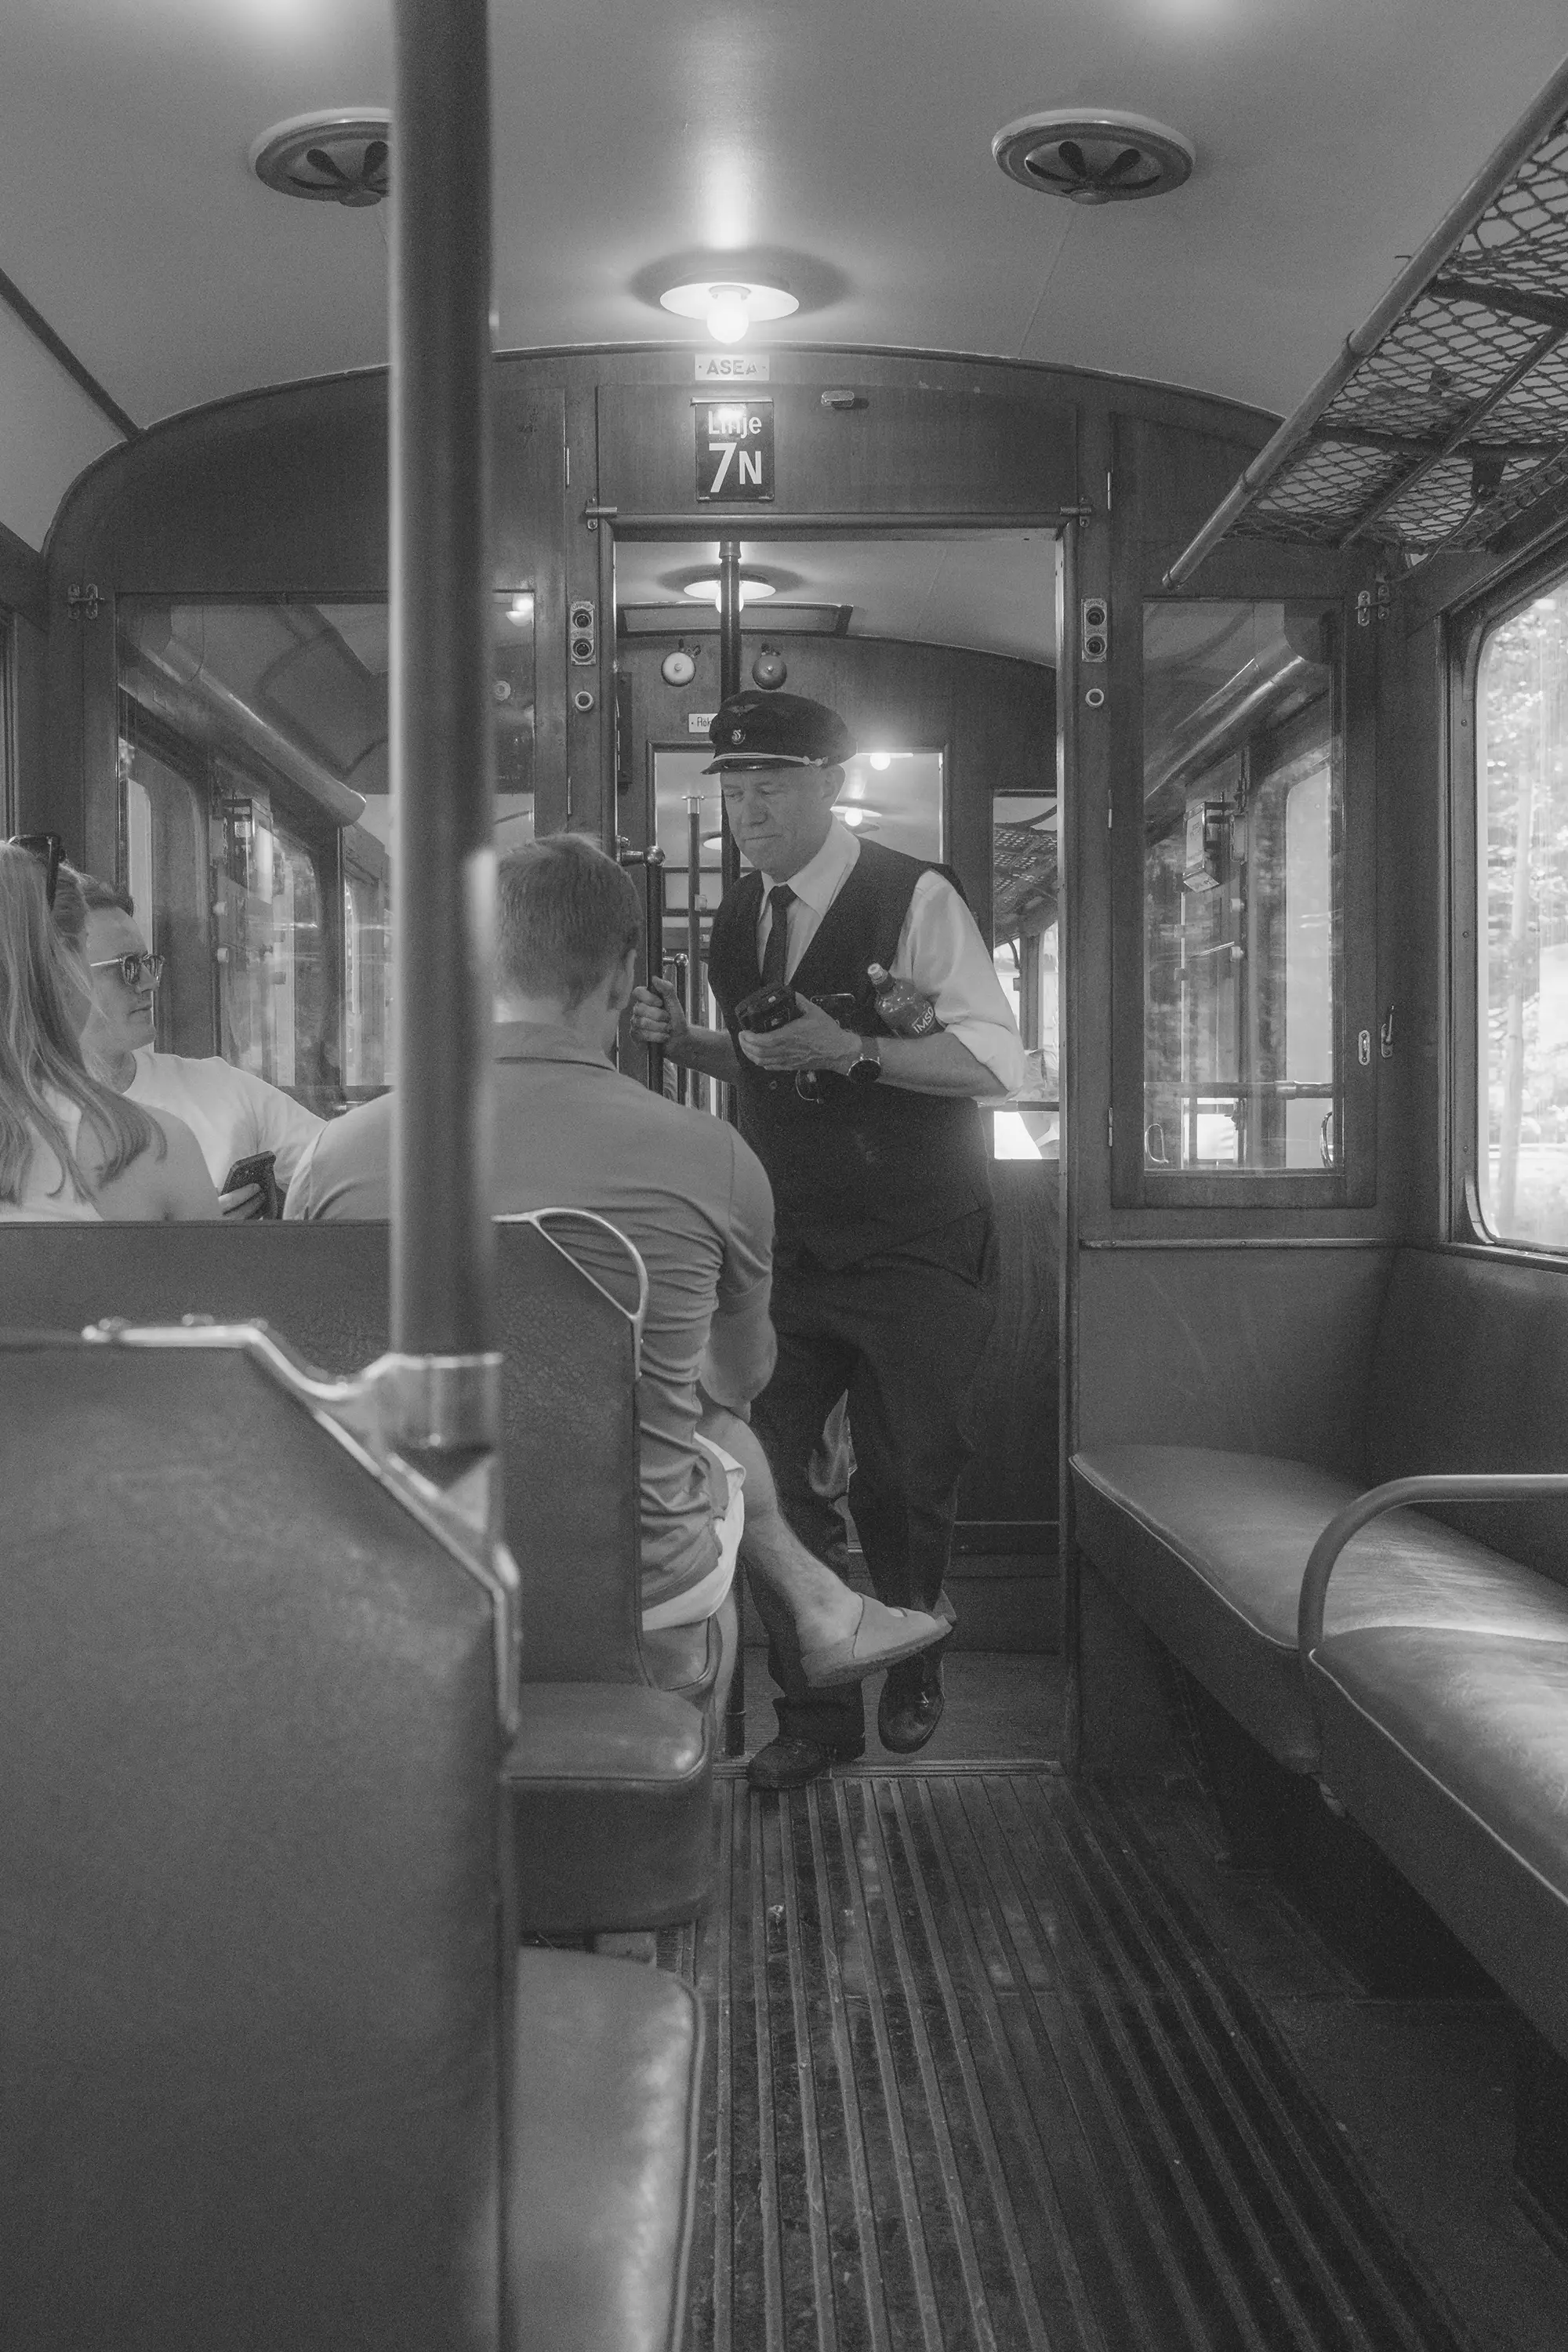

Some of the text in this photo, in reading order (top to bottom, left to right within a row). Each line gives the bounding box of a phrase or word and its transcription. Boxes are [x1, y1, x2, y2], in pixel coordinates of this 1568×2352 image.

[706, 359, 757, 375] ASEA
[708, 410, 762, 439] Linje
[709, 442, 762, 492] 7N
